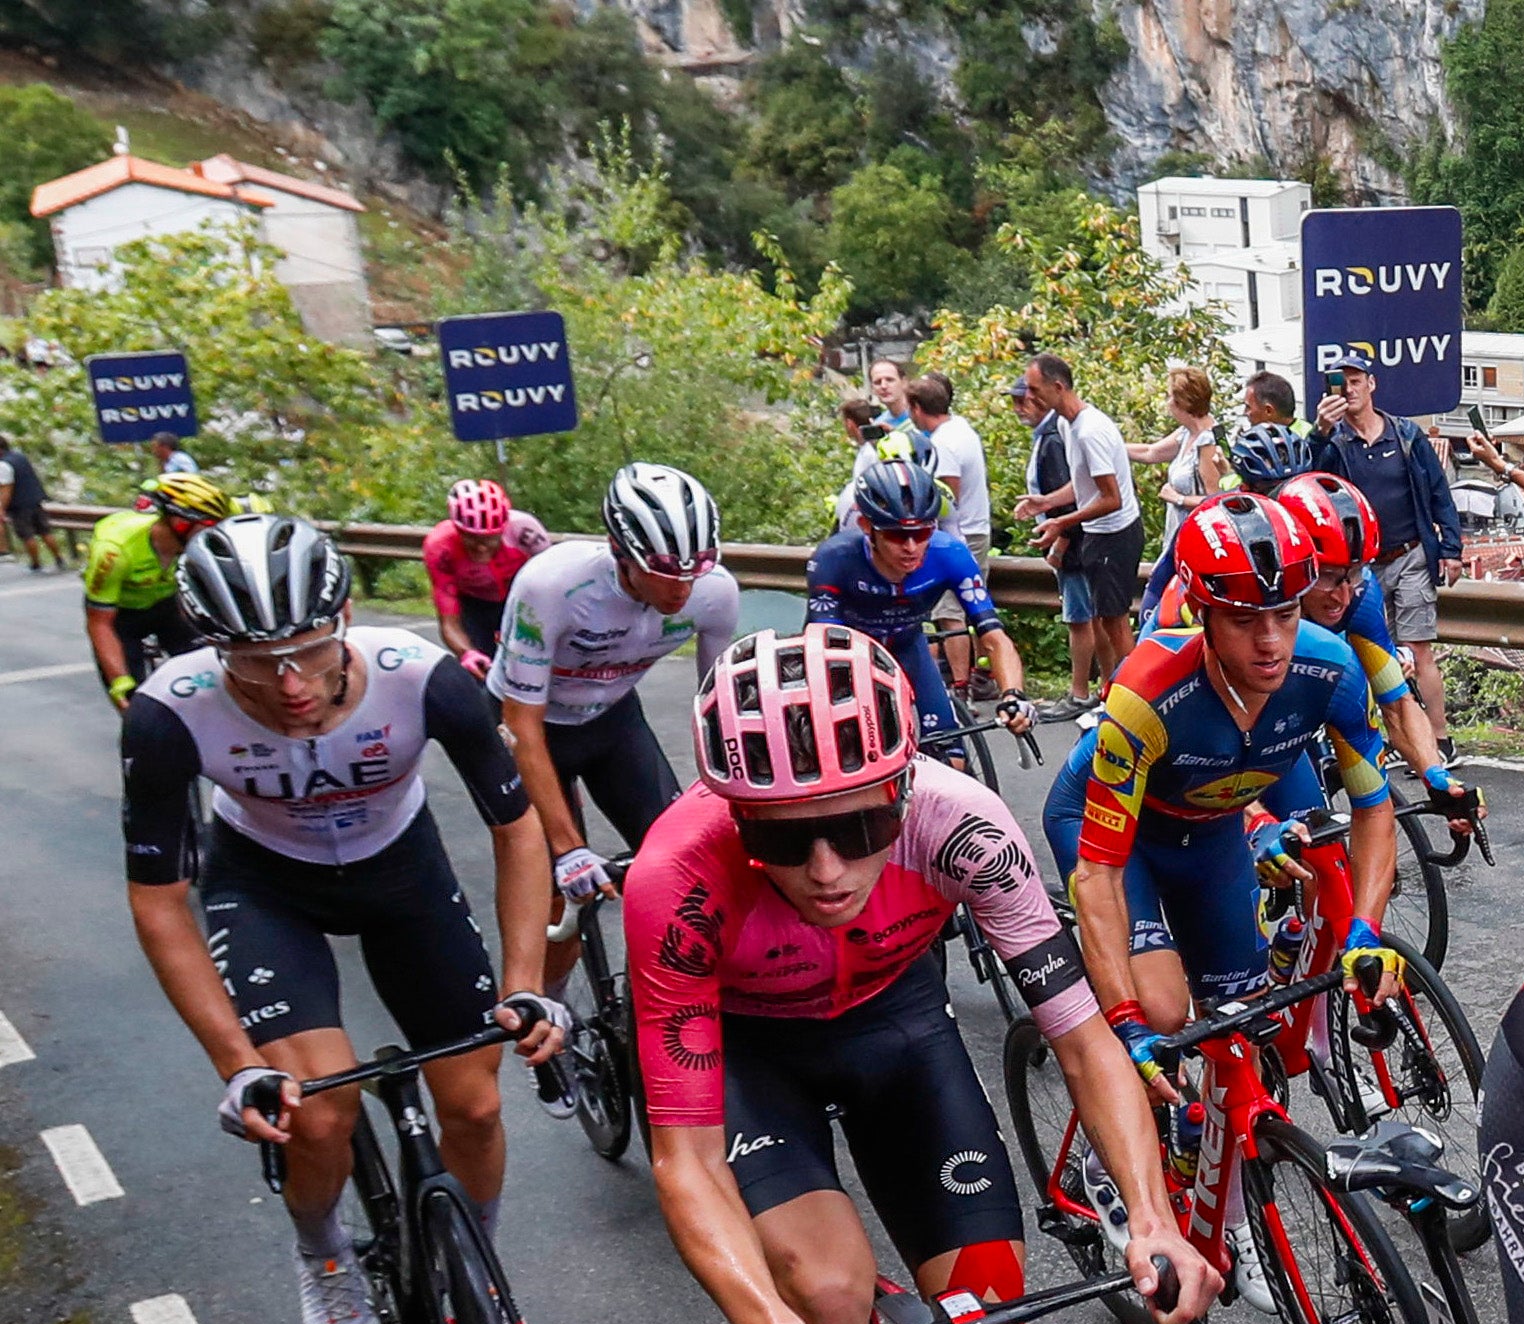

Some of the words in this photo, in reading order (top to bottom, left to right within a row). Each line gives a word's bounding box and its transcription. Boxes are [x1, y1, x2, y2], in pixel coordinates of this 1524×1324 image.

[1315, 262, 1451, 297] ROUVY
[449, 341, 560, 369] ROUVY
[96, 372, 184, 394] ROUVY
[455, 384, 566, 413] ROUVY
[100, 402, 190, 424] ROUVY
[1195, 509, 1227, 560] TREK
[1158, 677, 1201, 716] TREK
[244, 759, 391, 801] UAE
[1188, 1086, 1229, 1241] TREK
